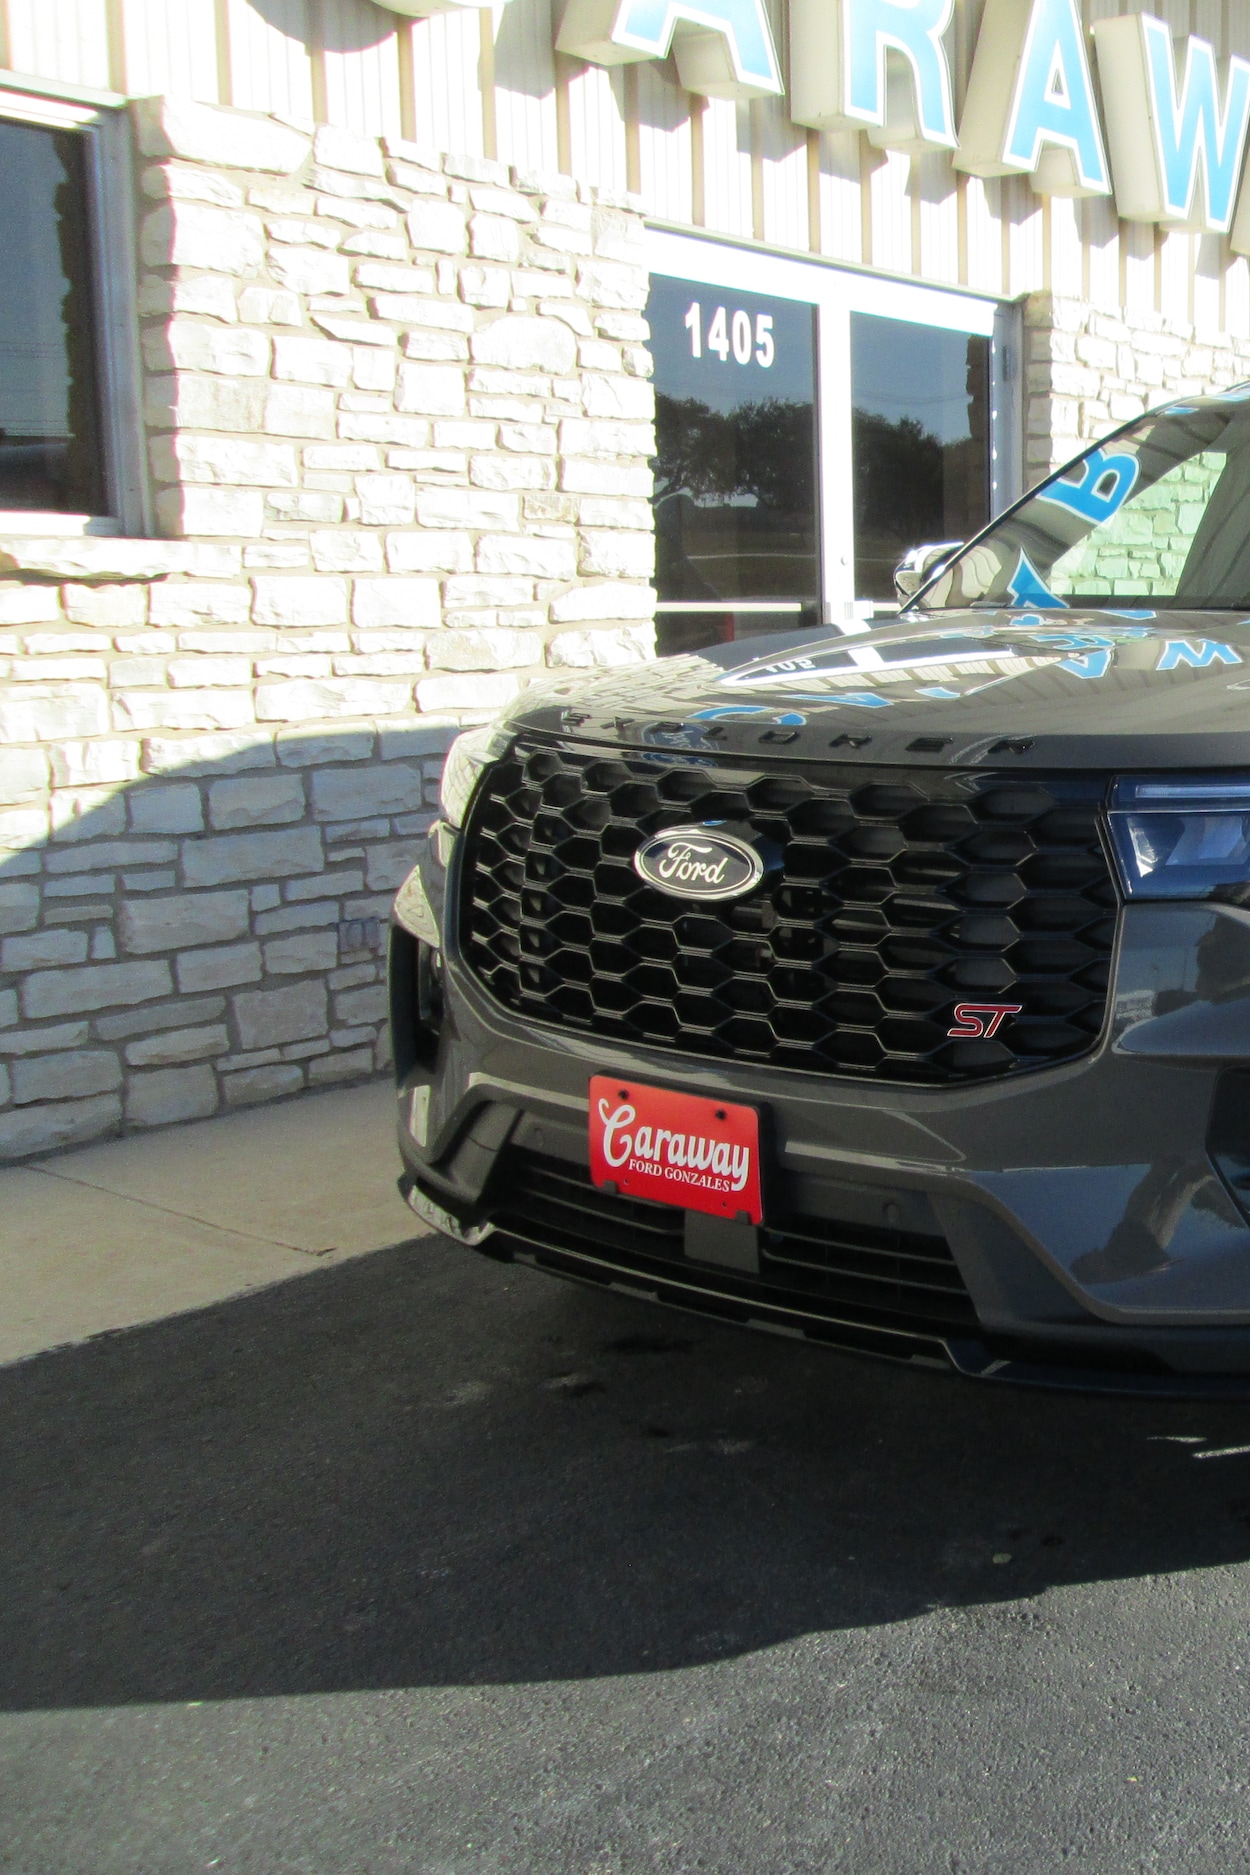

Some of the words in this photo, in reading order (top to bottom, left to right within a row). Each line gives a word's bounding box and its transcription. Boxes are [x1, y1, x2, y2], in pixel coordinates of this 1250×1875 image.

[685, 301, 775, 368] 1405
[560, 711, 1036, 755] EXPLORER
[657, 841, 726, 885] Ford
[946, 1002, 1023, 1039] ST
[598, 1098, 749, 1191] Caraway
[628, 1158, 663, 1176] FORD
[664, 1166, 732, 1192] GONZALES
